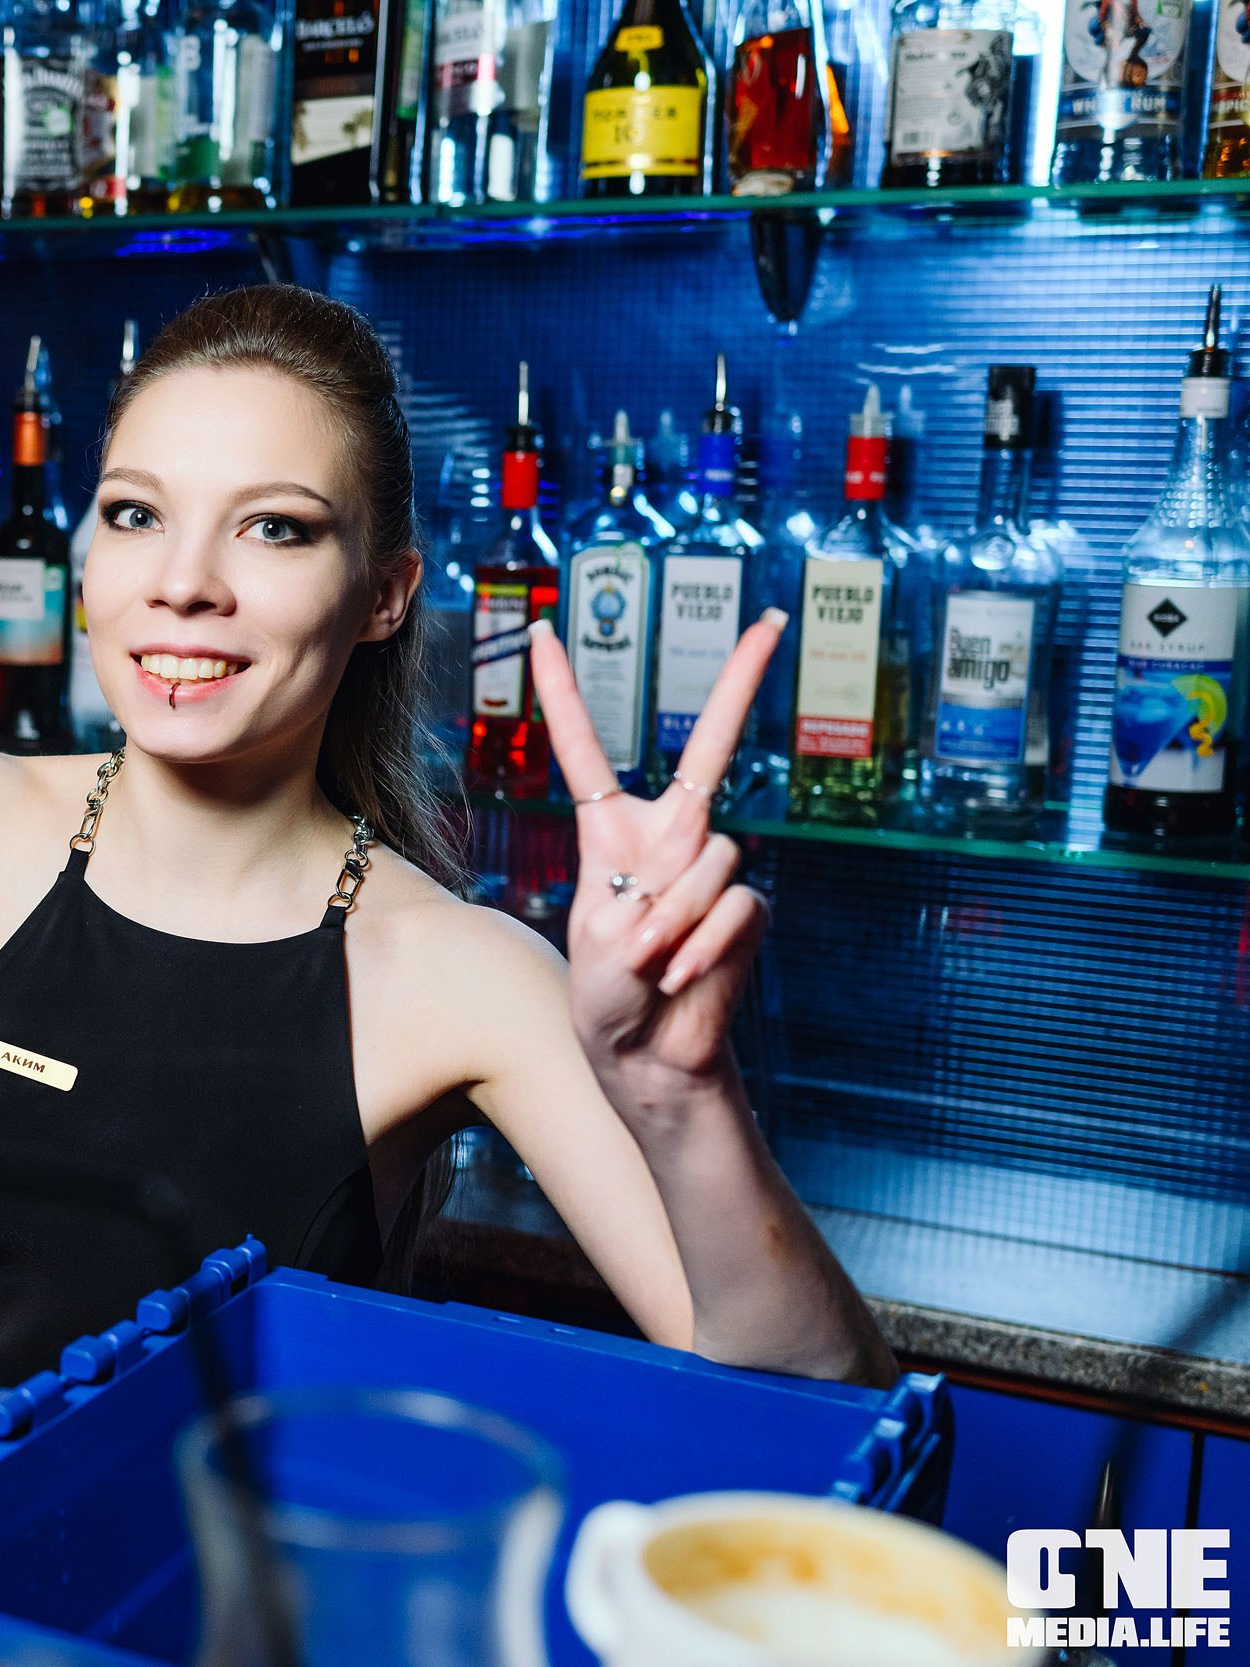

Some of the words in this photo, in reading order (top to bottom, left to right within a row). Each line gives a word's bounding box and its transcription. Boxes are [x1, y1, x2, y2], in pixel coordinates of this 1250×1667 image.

[1072, 96, 1127, 116] WHE
[671, 582, 733, 601] PUEBLO
[812, 584, 874, 603] PUEBLO
[676, 603, 724, 621] VIEJO
[817, 606, 864, 623] VIEJO
[949, 657, 1011, 690] amigo
[662, 715, 693, 730] BLA
[1, 1051, 45, 1073] АКИМ
